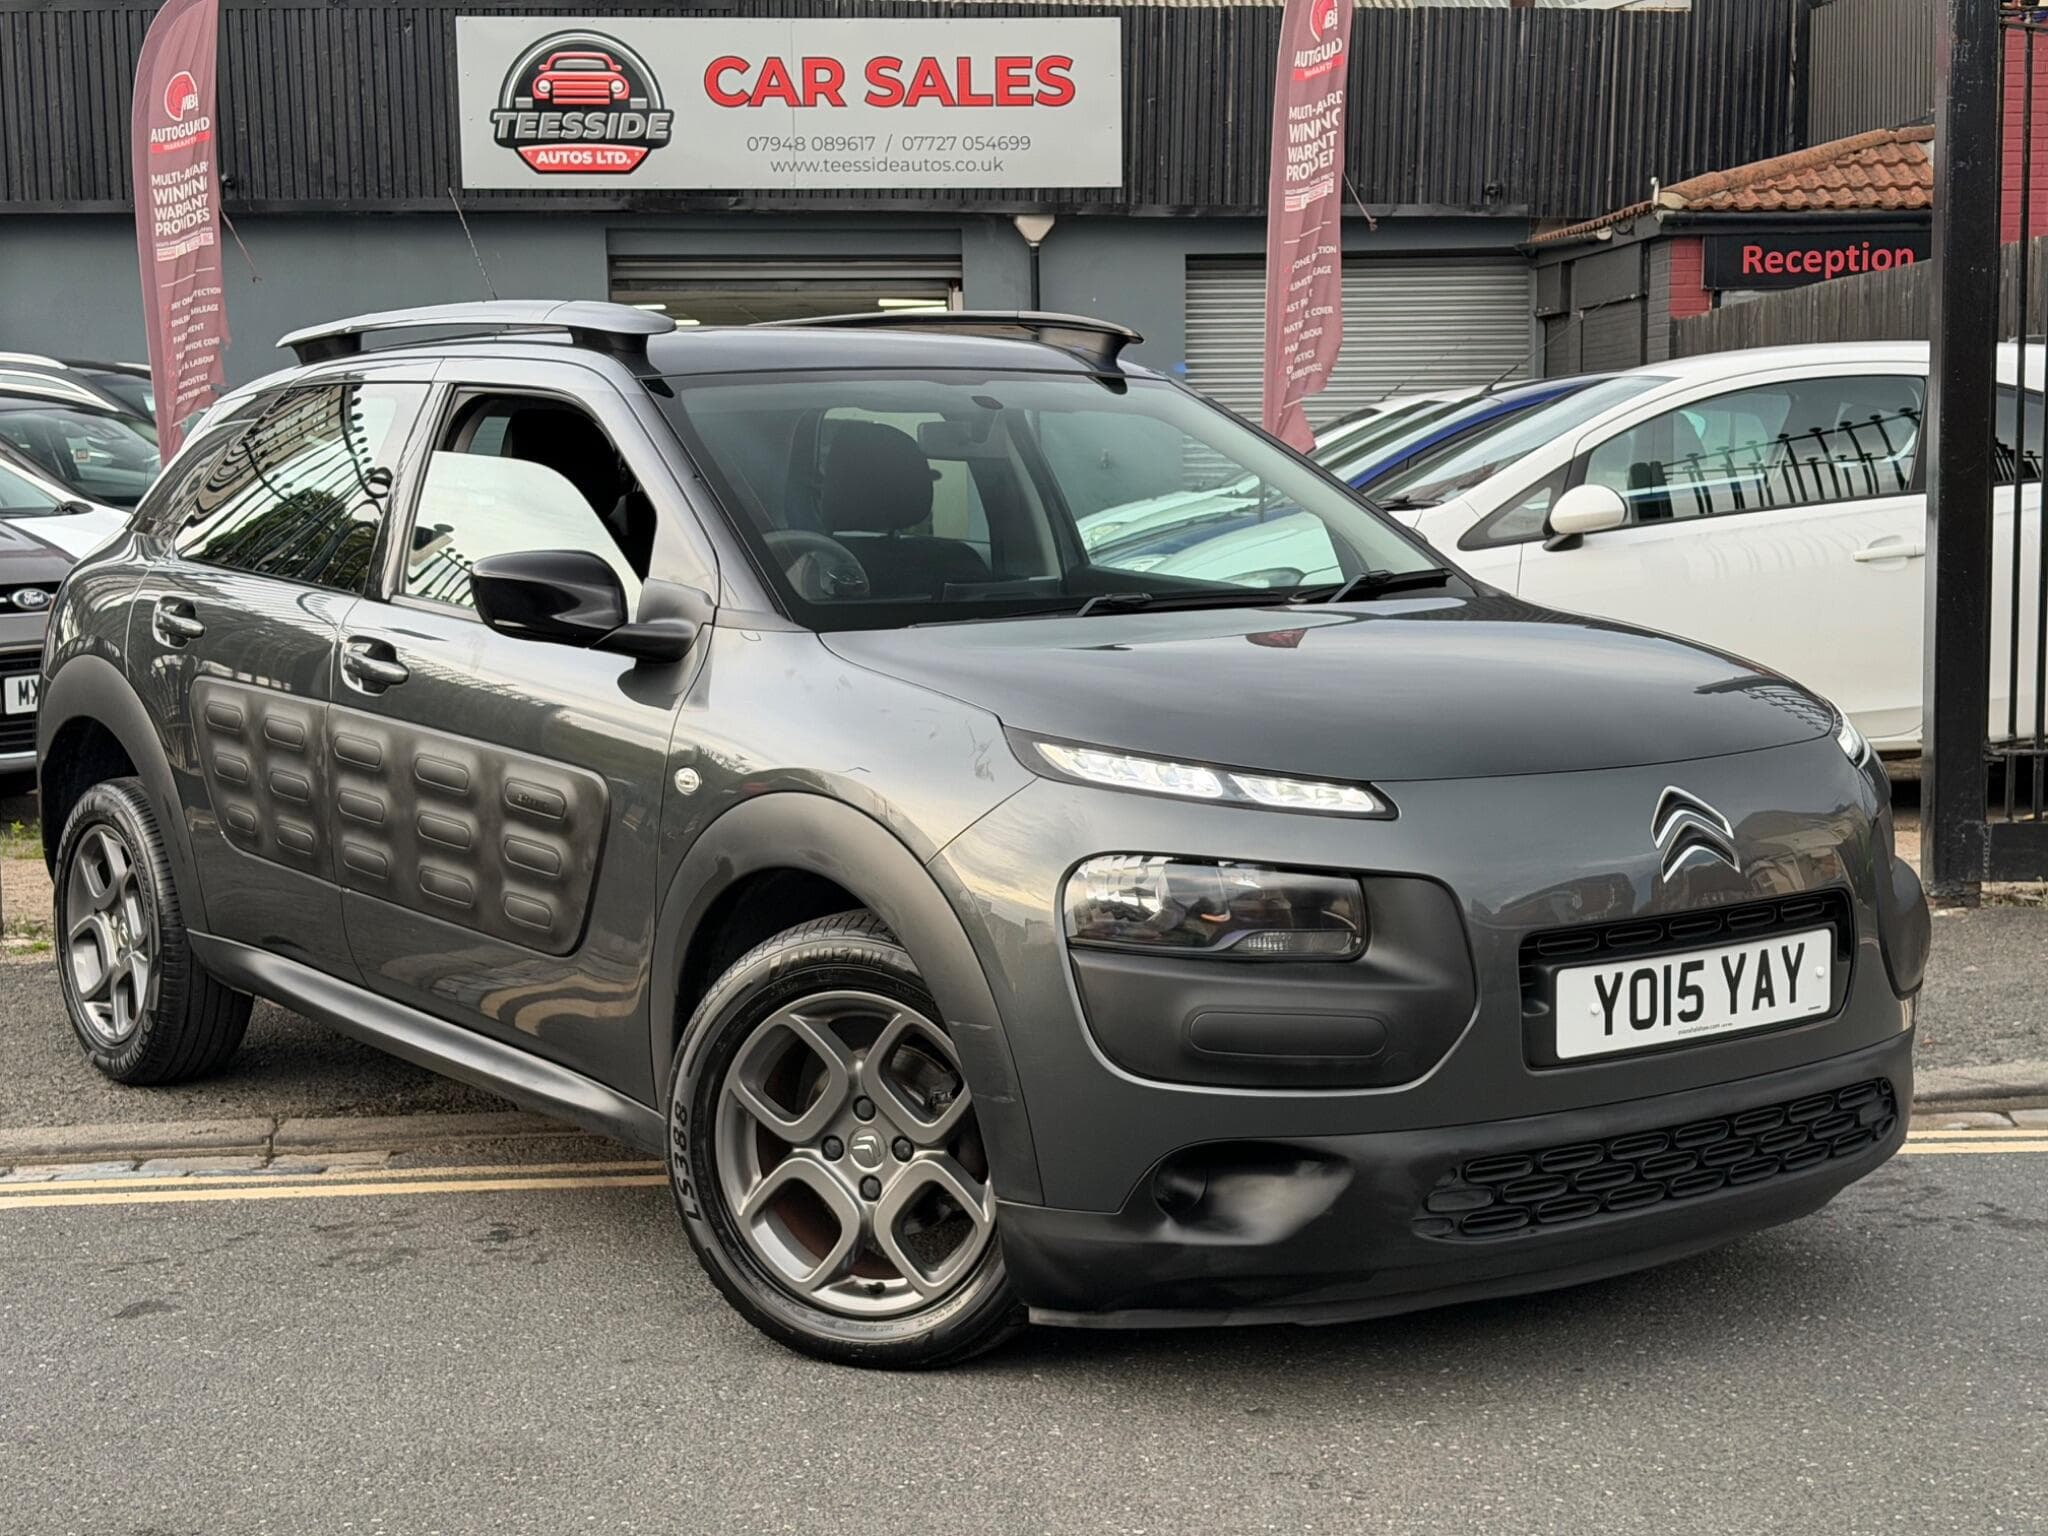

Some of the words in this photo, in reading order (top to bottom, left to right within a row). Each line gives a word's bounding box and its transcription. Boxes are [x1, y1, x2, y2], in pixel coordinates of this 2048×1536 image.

[703, 55, 848, 109] CAR
[864, 55, 1076, 109] SALES
[492, 111, 672, 140] TEESSIDE
[746, 136, 807, 152] 07948
[811, 136, 876, 152] 089617
[885, 134, 894, 153] /
[902, 136, 957, 151] 07727
[962, 136, 1031, 151] 054699
[536, 151, 593, 165] AUTOS
[596, 151, 631, 165] LTD.
[770, 156, 1004, 173] www.teessideautos.co.uk
[1742, 242, 1914, 279] Reception
[24, 592, 45, 606] Ford
[1593, 959, 1705, 1036] YO15
[1721, 942, 1806, 1016] YAY
